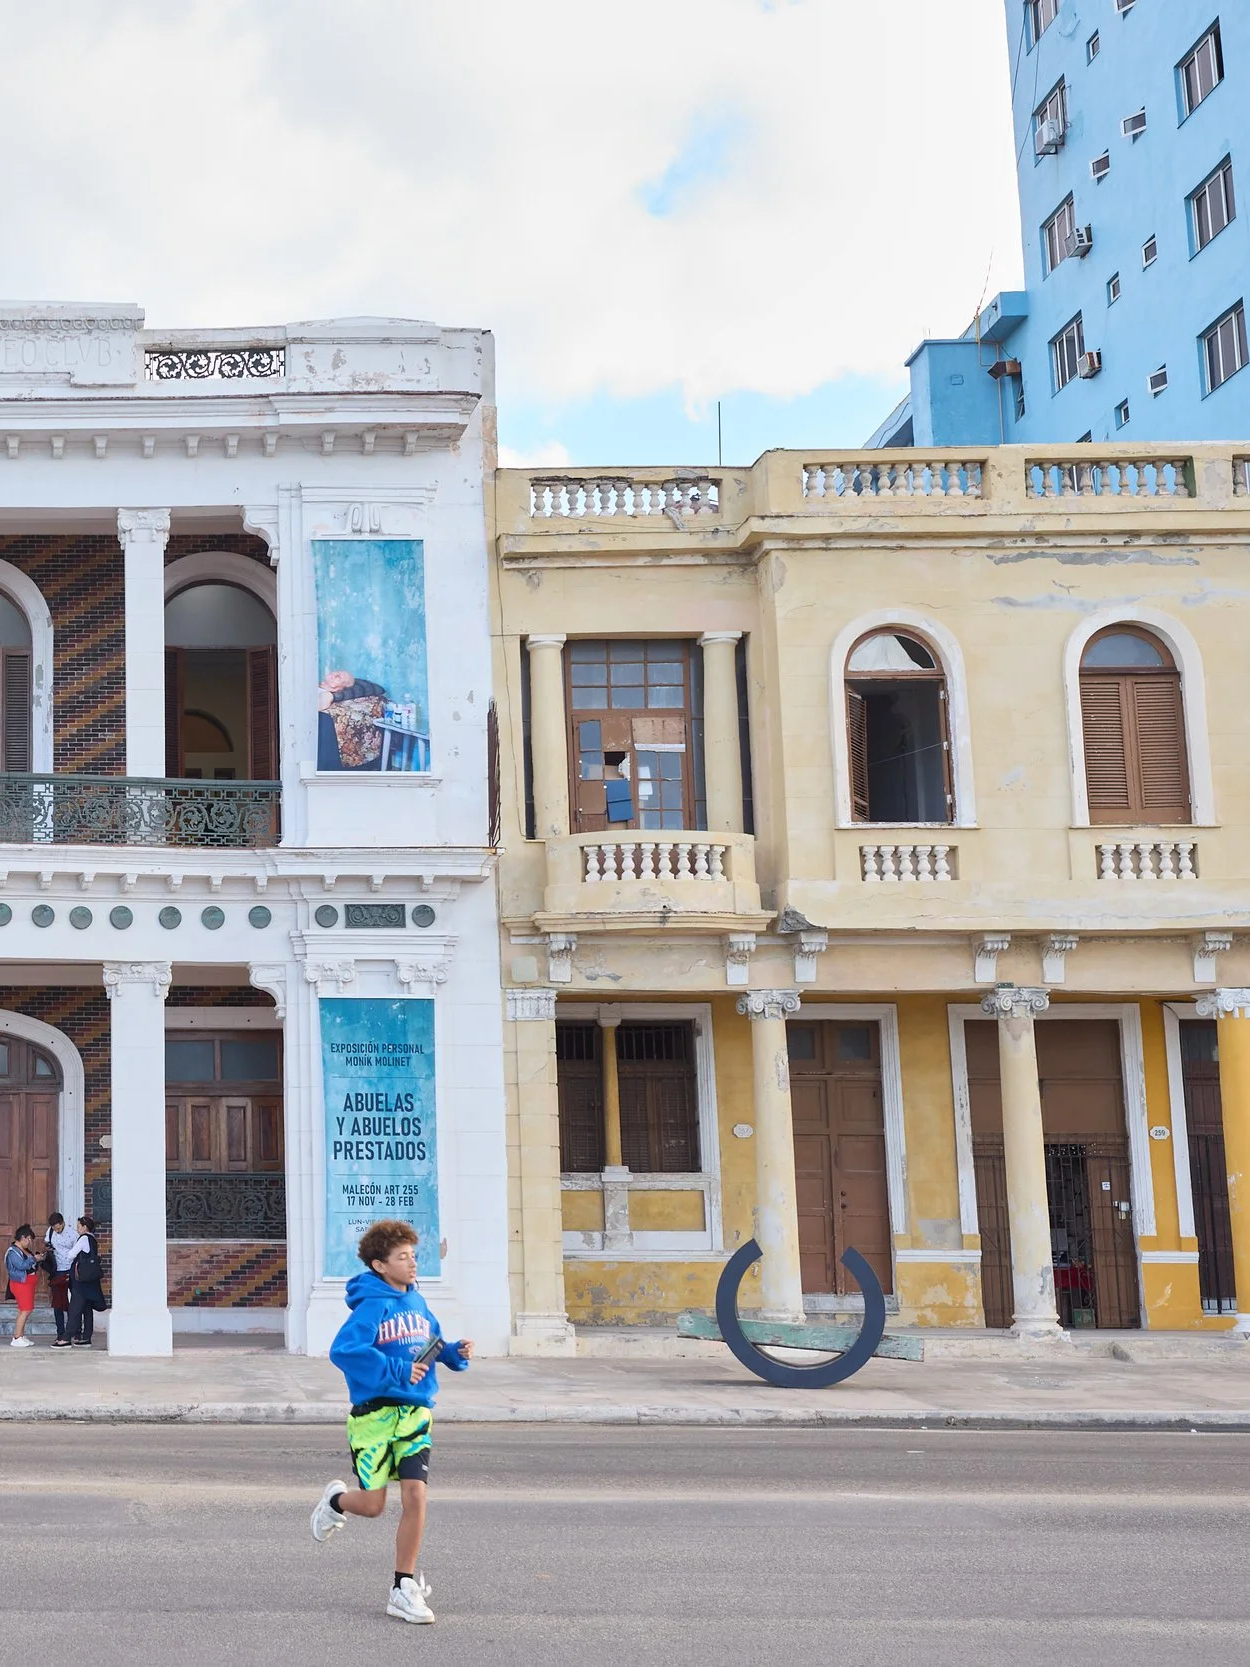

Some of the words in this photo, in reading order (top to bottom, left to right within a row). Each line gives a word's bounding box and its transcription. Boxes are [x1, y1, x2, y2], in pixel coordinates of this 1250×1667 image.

[330, 1041, 379, 1054] EXPOSICIÓN
[382, 1043, 425, 1054] PERSONAL
[346, 1054, 373, 1067] MONÍK
[375, 1056, 411, 1067] MOLINET
[343, 1093, 414, 1112] ABUELAS
[336, 1117, 345, 1136] Y
[351, 1117, 422, 1137] ABUELOS
[333, 1141, 427, 1161] PRESTADOS
[342, 1182, 381, 1195] MALECÓN
[384, 1185, 400, 1195] ART
[402, 1185, 419, 1195] 255
[347, 1196, 356, 1206] 17
[358, 1196, 375, 1206] NOV
[385, 1196, 396, 1206] 28
[398, 1196, 414, 1206] FEB
